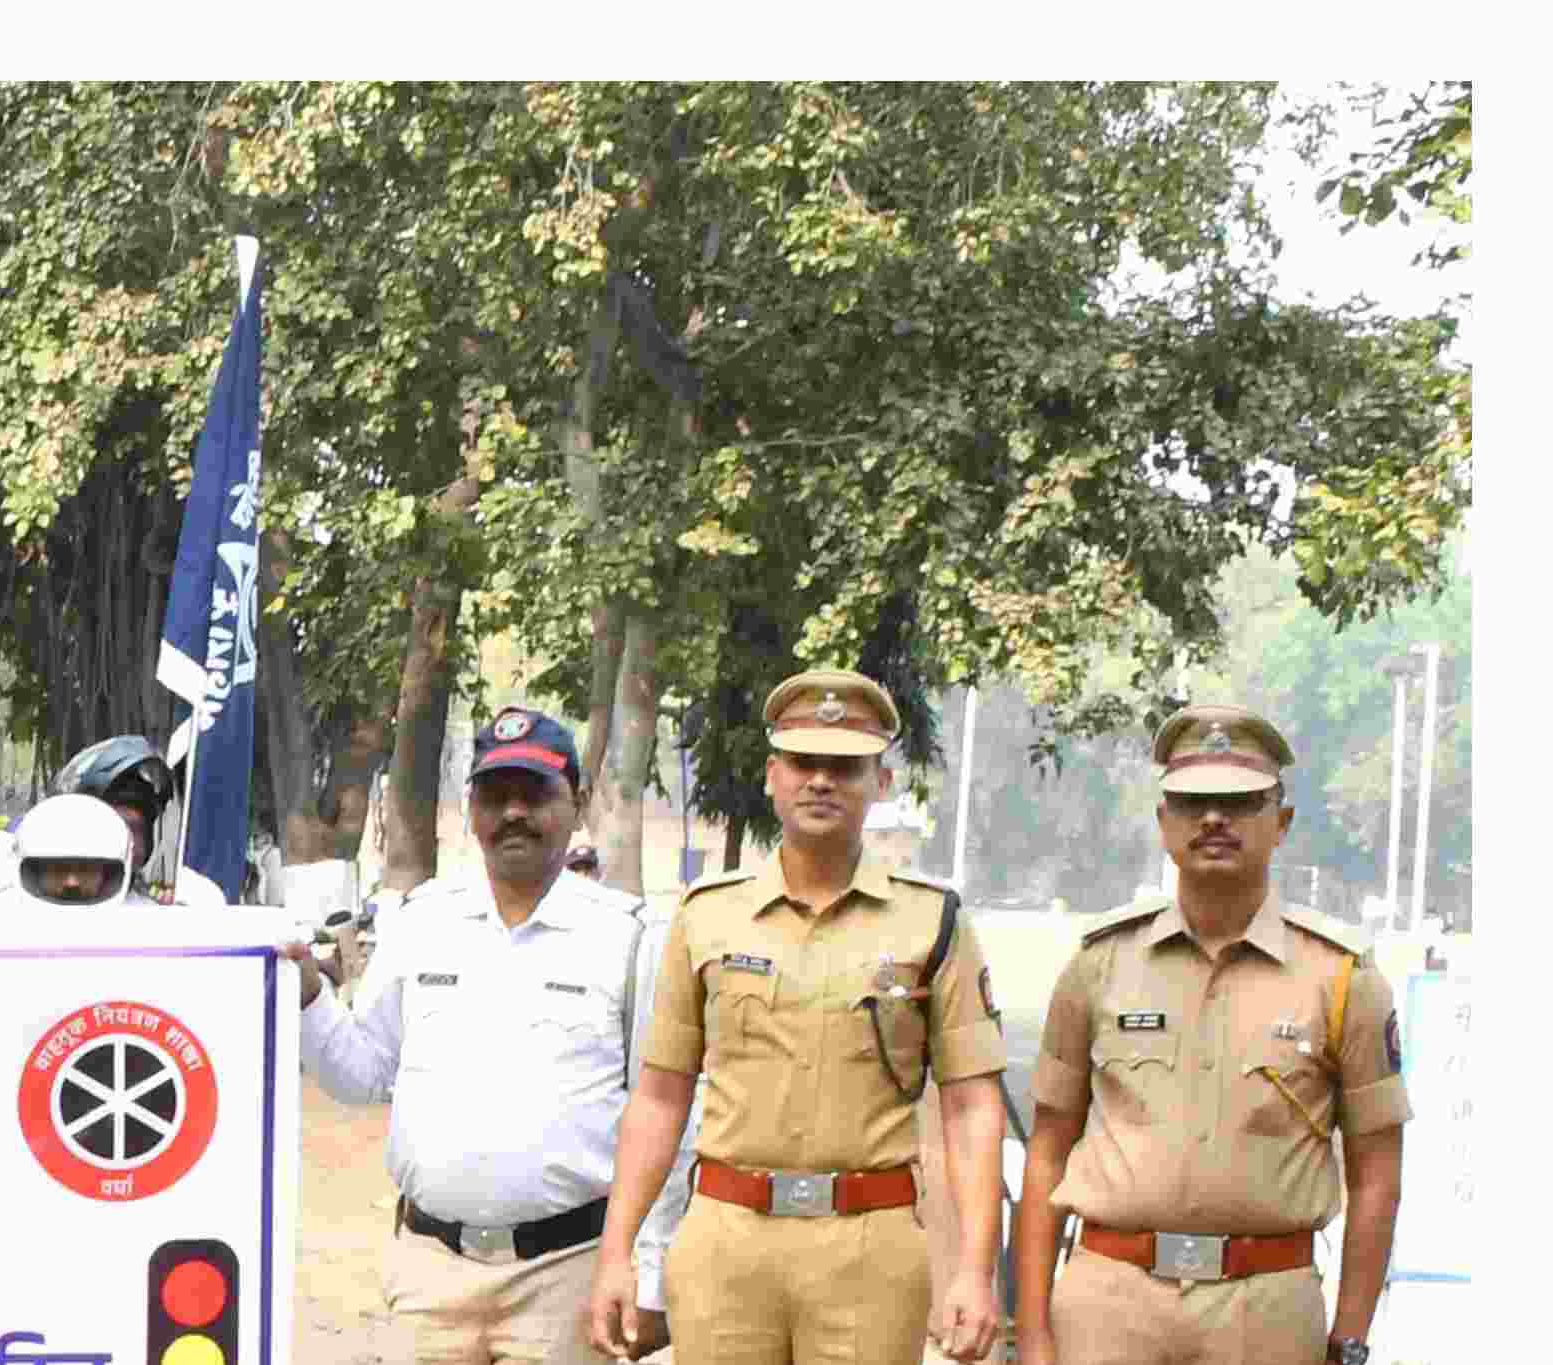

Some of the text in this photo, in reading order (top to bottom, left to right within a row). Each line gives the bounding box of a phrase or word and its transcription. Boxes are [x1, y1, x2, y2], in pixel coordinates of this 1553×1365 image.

[31, 1007, 205, 1072] वाहतूक नियंत्रण शाखा
[100, 1171, 135, 1196] वर्धा
